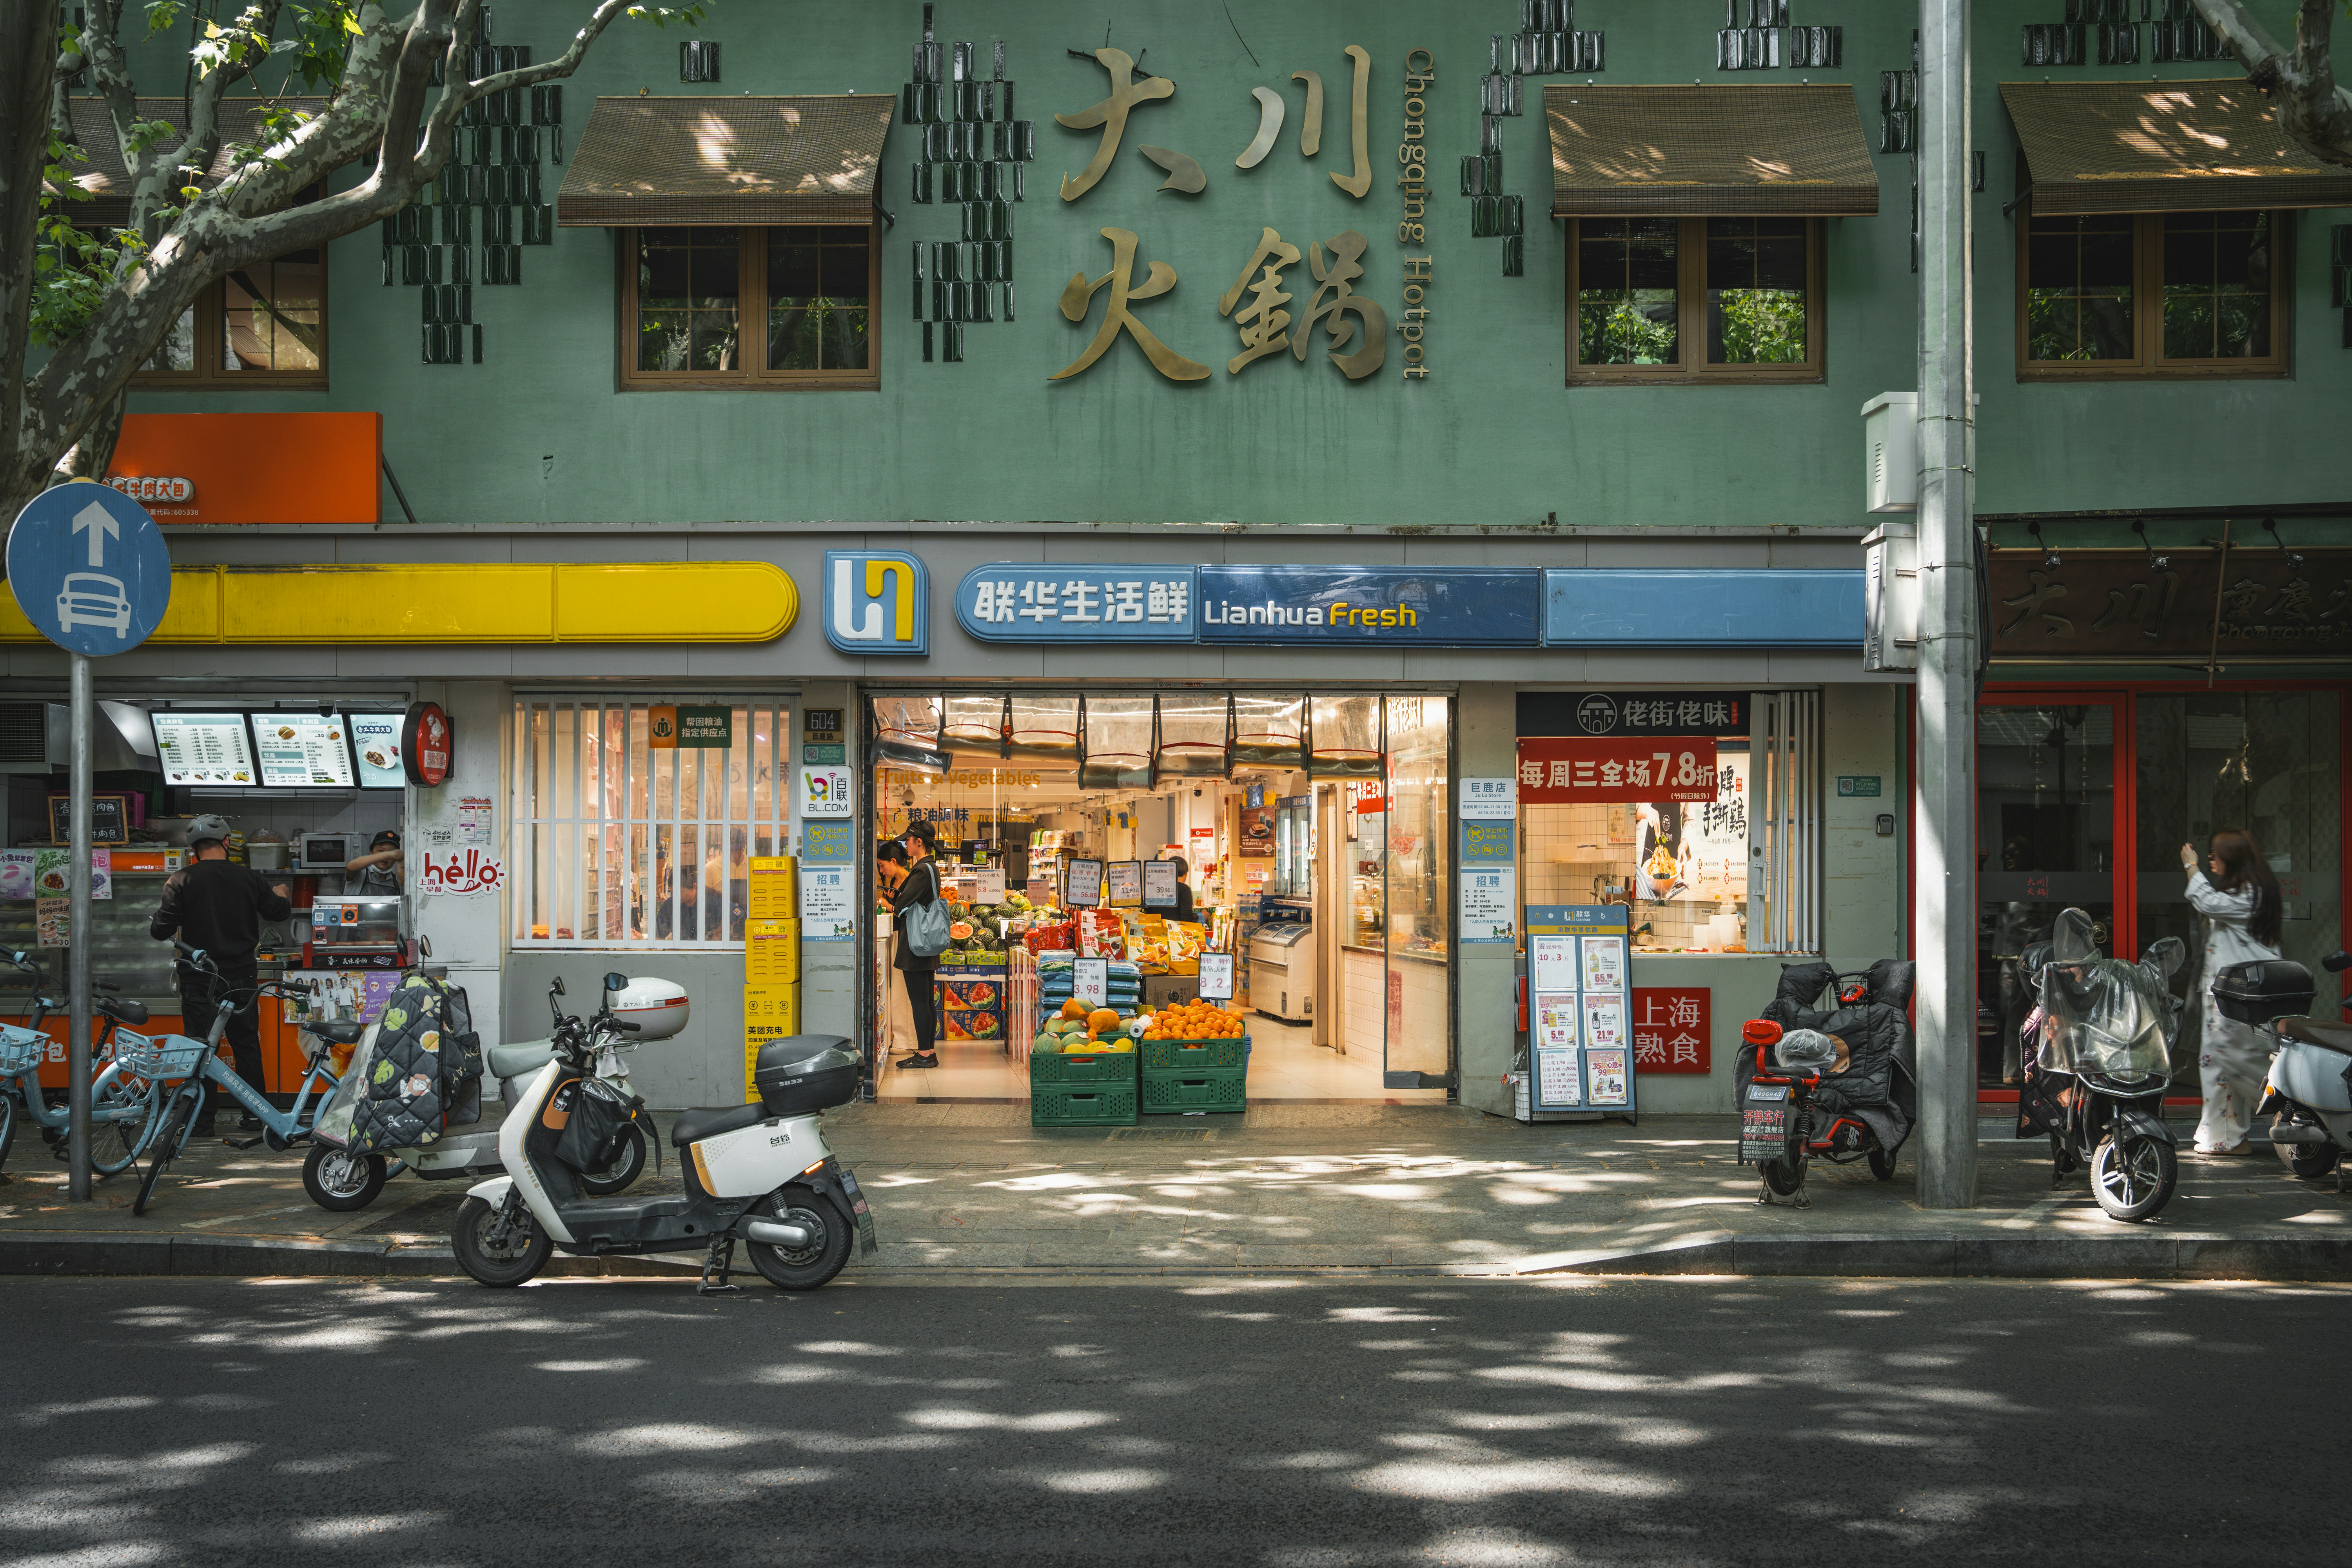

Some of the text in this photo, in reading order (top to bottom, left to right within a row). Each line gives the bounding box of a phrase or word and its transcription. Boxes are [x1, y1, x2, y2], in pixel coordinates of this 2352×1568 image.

[1054, 45, 1372, 202] 大川
[1396, 46, 1435, 379] Chongqing Hotpot
[974, 580, 1189, 624] 联华生活鲜
[1205, 600, 1417, 628] Lianhua Fresh
[686, 717, 722, 726] 帮困粮油
[811, 713, 835, 729] 604
[682, 728, 727, 737] 指定供应点
[1520, 751, 1715, 788] 每周三全场7.8折
[876, 770, 925, 784] Fruits
[948, 770, 1041, 789] Vegetables
[1471, 782, 1506, 792] 巨鹿店
[836, 779, 847, 801] 百联
[907, 808, 969, 822] 粮油调味
[817, 874, 840, 885] 招聘
[1476, 875, 1499, 886] 招聘
[1074, 984, 1099, 994] 3.98
[1200, 977, 1207, 987] 8
[1216, 978, 1223, 987] 2
[1635, 996, 1700, 1028] 上海
[1634, 1032, 1700, 1064] 熟食
[222, 1071, 244, 1091] 约顺风车
[779, 1078, 803, 1087] SH33
[1744, 1110, 1784, 1125] 开静车行
[770, 1134, 790, 1144] 台铃
[1847, 1126, 1860, 1149] 95
